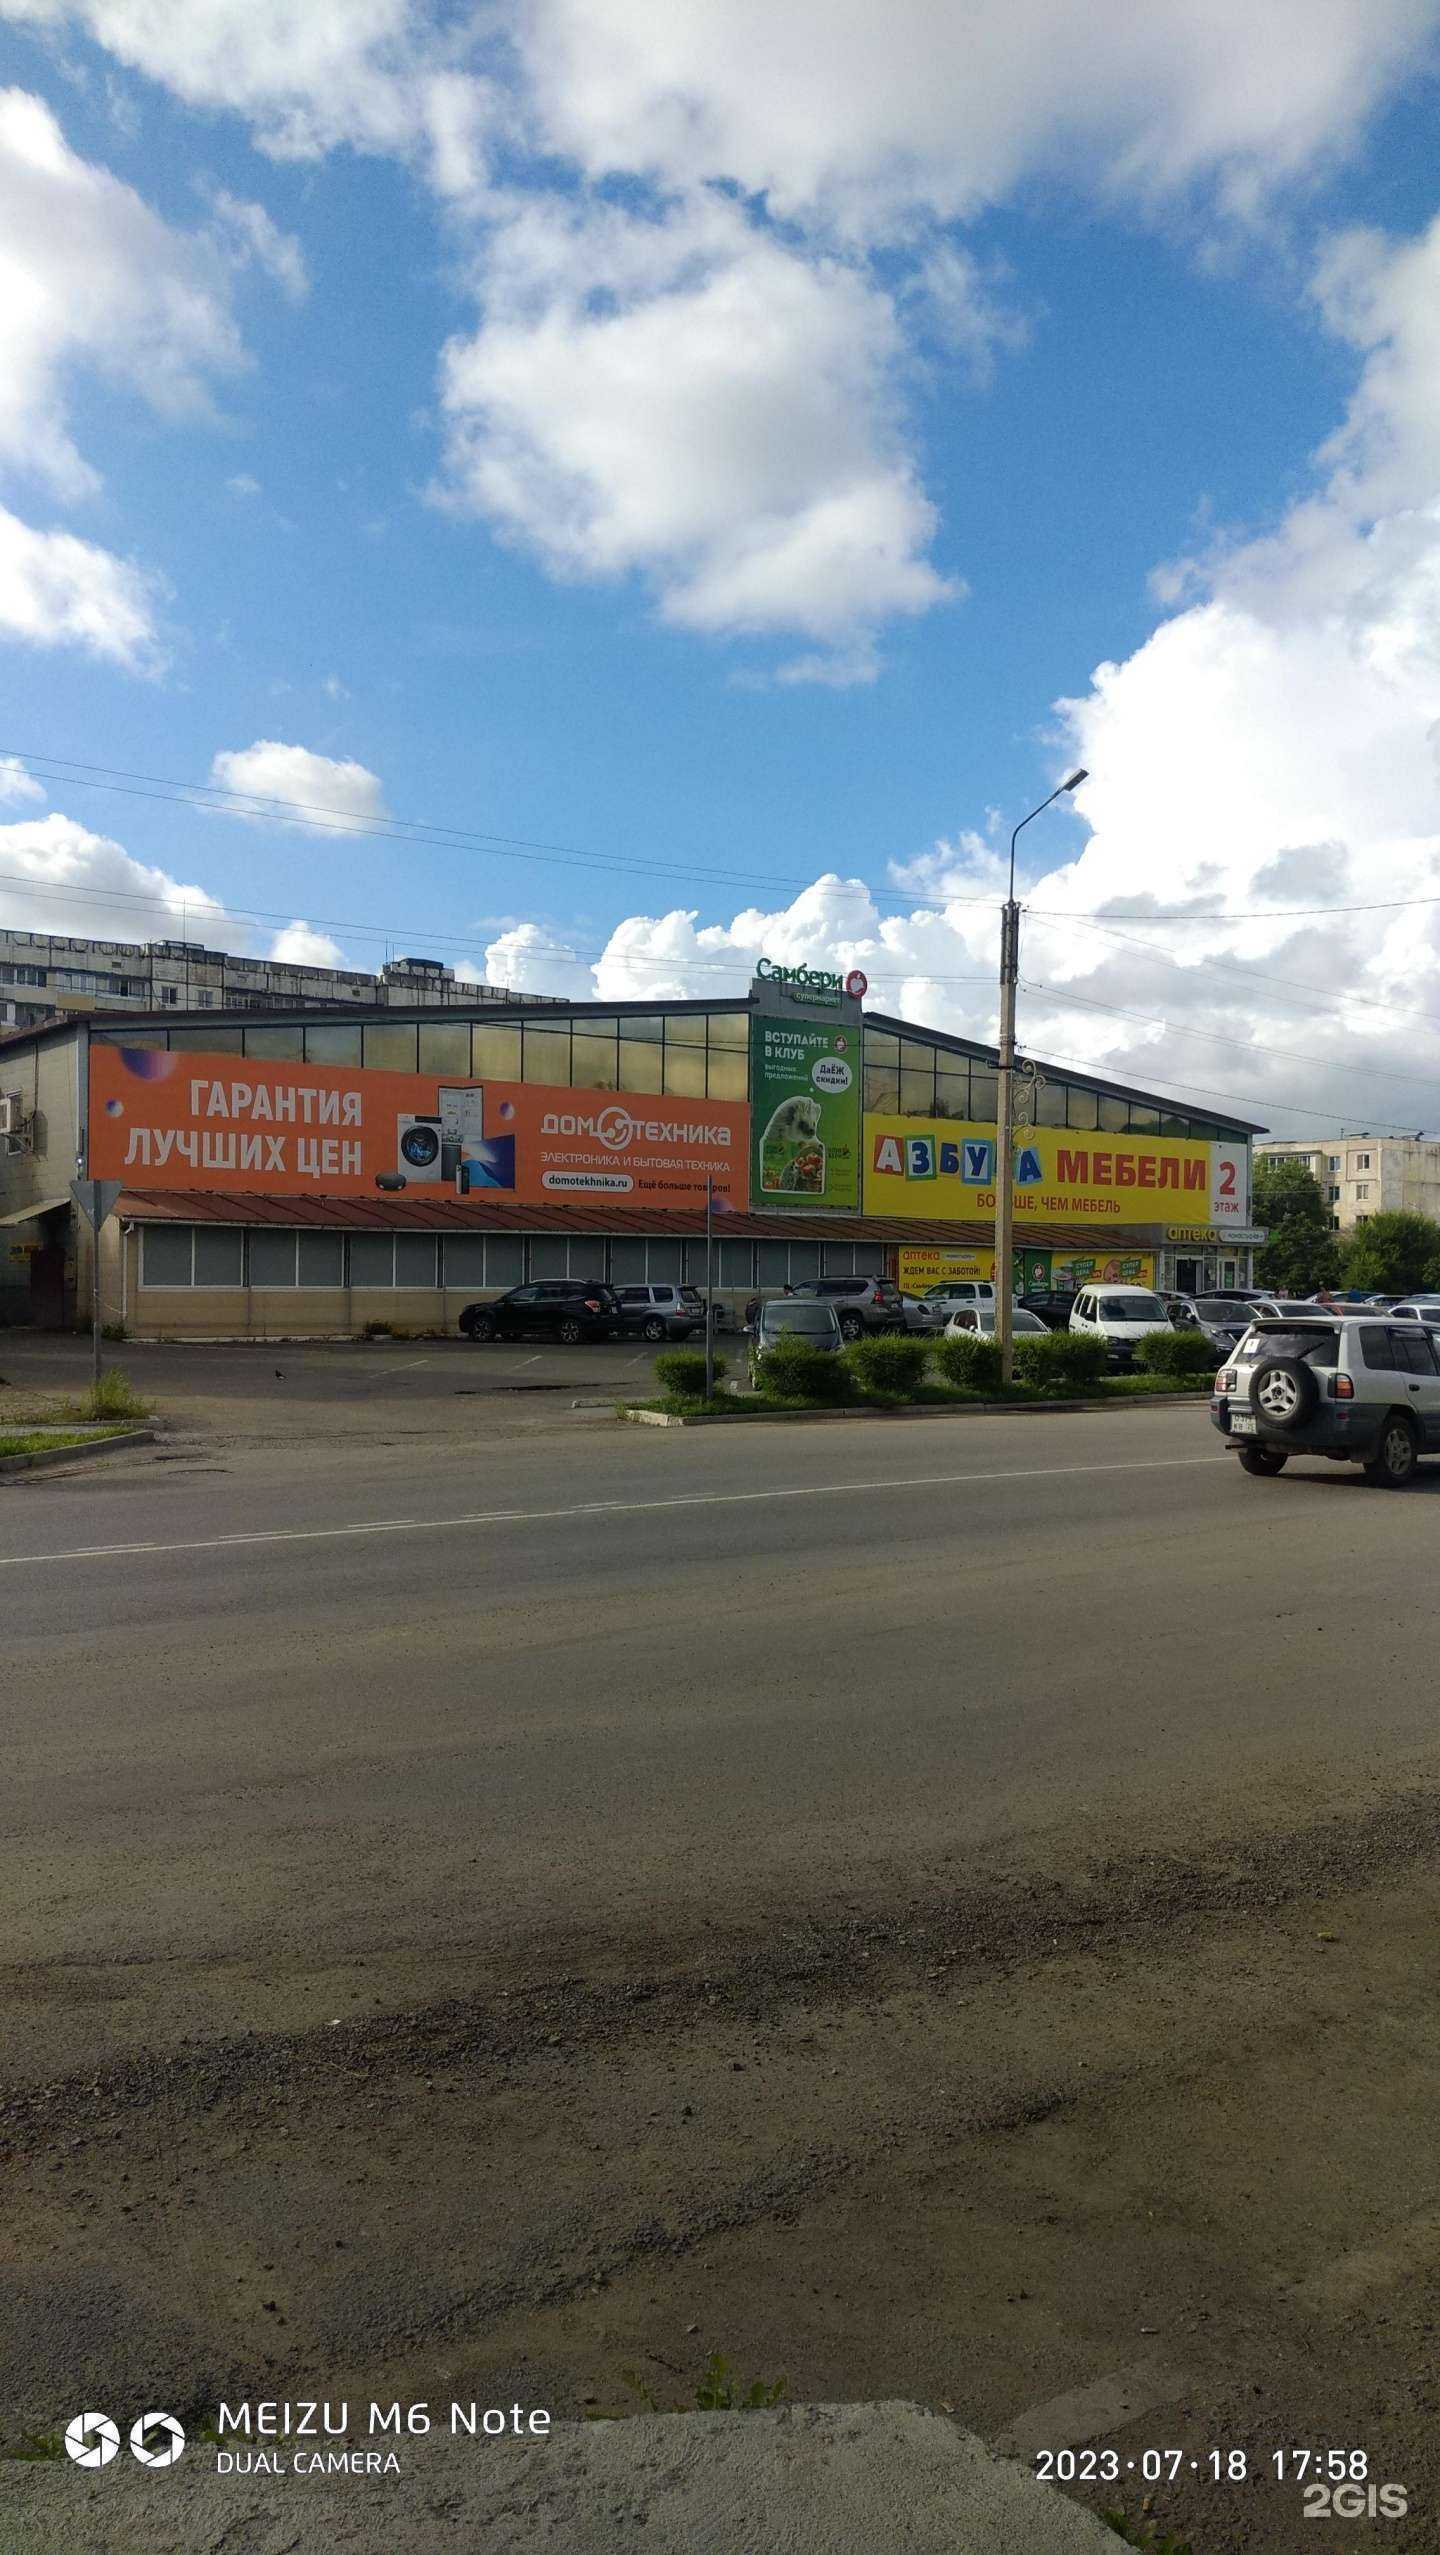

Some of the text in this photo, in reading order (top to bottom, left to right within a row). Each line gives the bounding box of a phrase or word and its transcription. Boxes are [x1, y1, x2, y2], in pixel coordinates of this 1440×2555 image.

[756, 957, 843, 989] Самбери
[764, 1030, 829, 1049] ВСТУПАЙТЕ
[764, 1045, 805, 1060] В КЛУБ
[815, 1076, 848, 1086] скидки!
[190, 1079, 362, 1127] ГАРАНТИЯ
[124, 1127, 362, 1178] ЛУЧШИХ ЦЕН
[541, 1151, 730, 1172] ЭЛЕКТРОНИКА И БЫТОВАЯ ТЕХНИКА
[875, 1137, 1206, 1191] АЗБУА МЕБЕЛИ
[548, 1175, 628, 1188] domotekhnika.ru
[638, 1178, 731, 1194] Ещё больше товров!
[1219, 1161, 1236, 1196] 2
[976, 1193, 1121, 1214] БОШЕ, ЧЕМ МЕБЕЛЬ
[1214, 1202, 1239, 1213] этаж
[1167, 1227, 1217, 1241] аптека
[903, 1250, 940, 1260] аптека
[903, 1266, 925, 1275] ЖДЕМ
[926, 1266, 940, 1275] ВАС
[941, 1266, 947, 1275] С
[949, 1265, 981, 1276] ЗАБОТОЙ!
